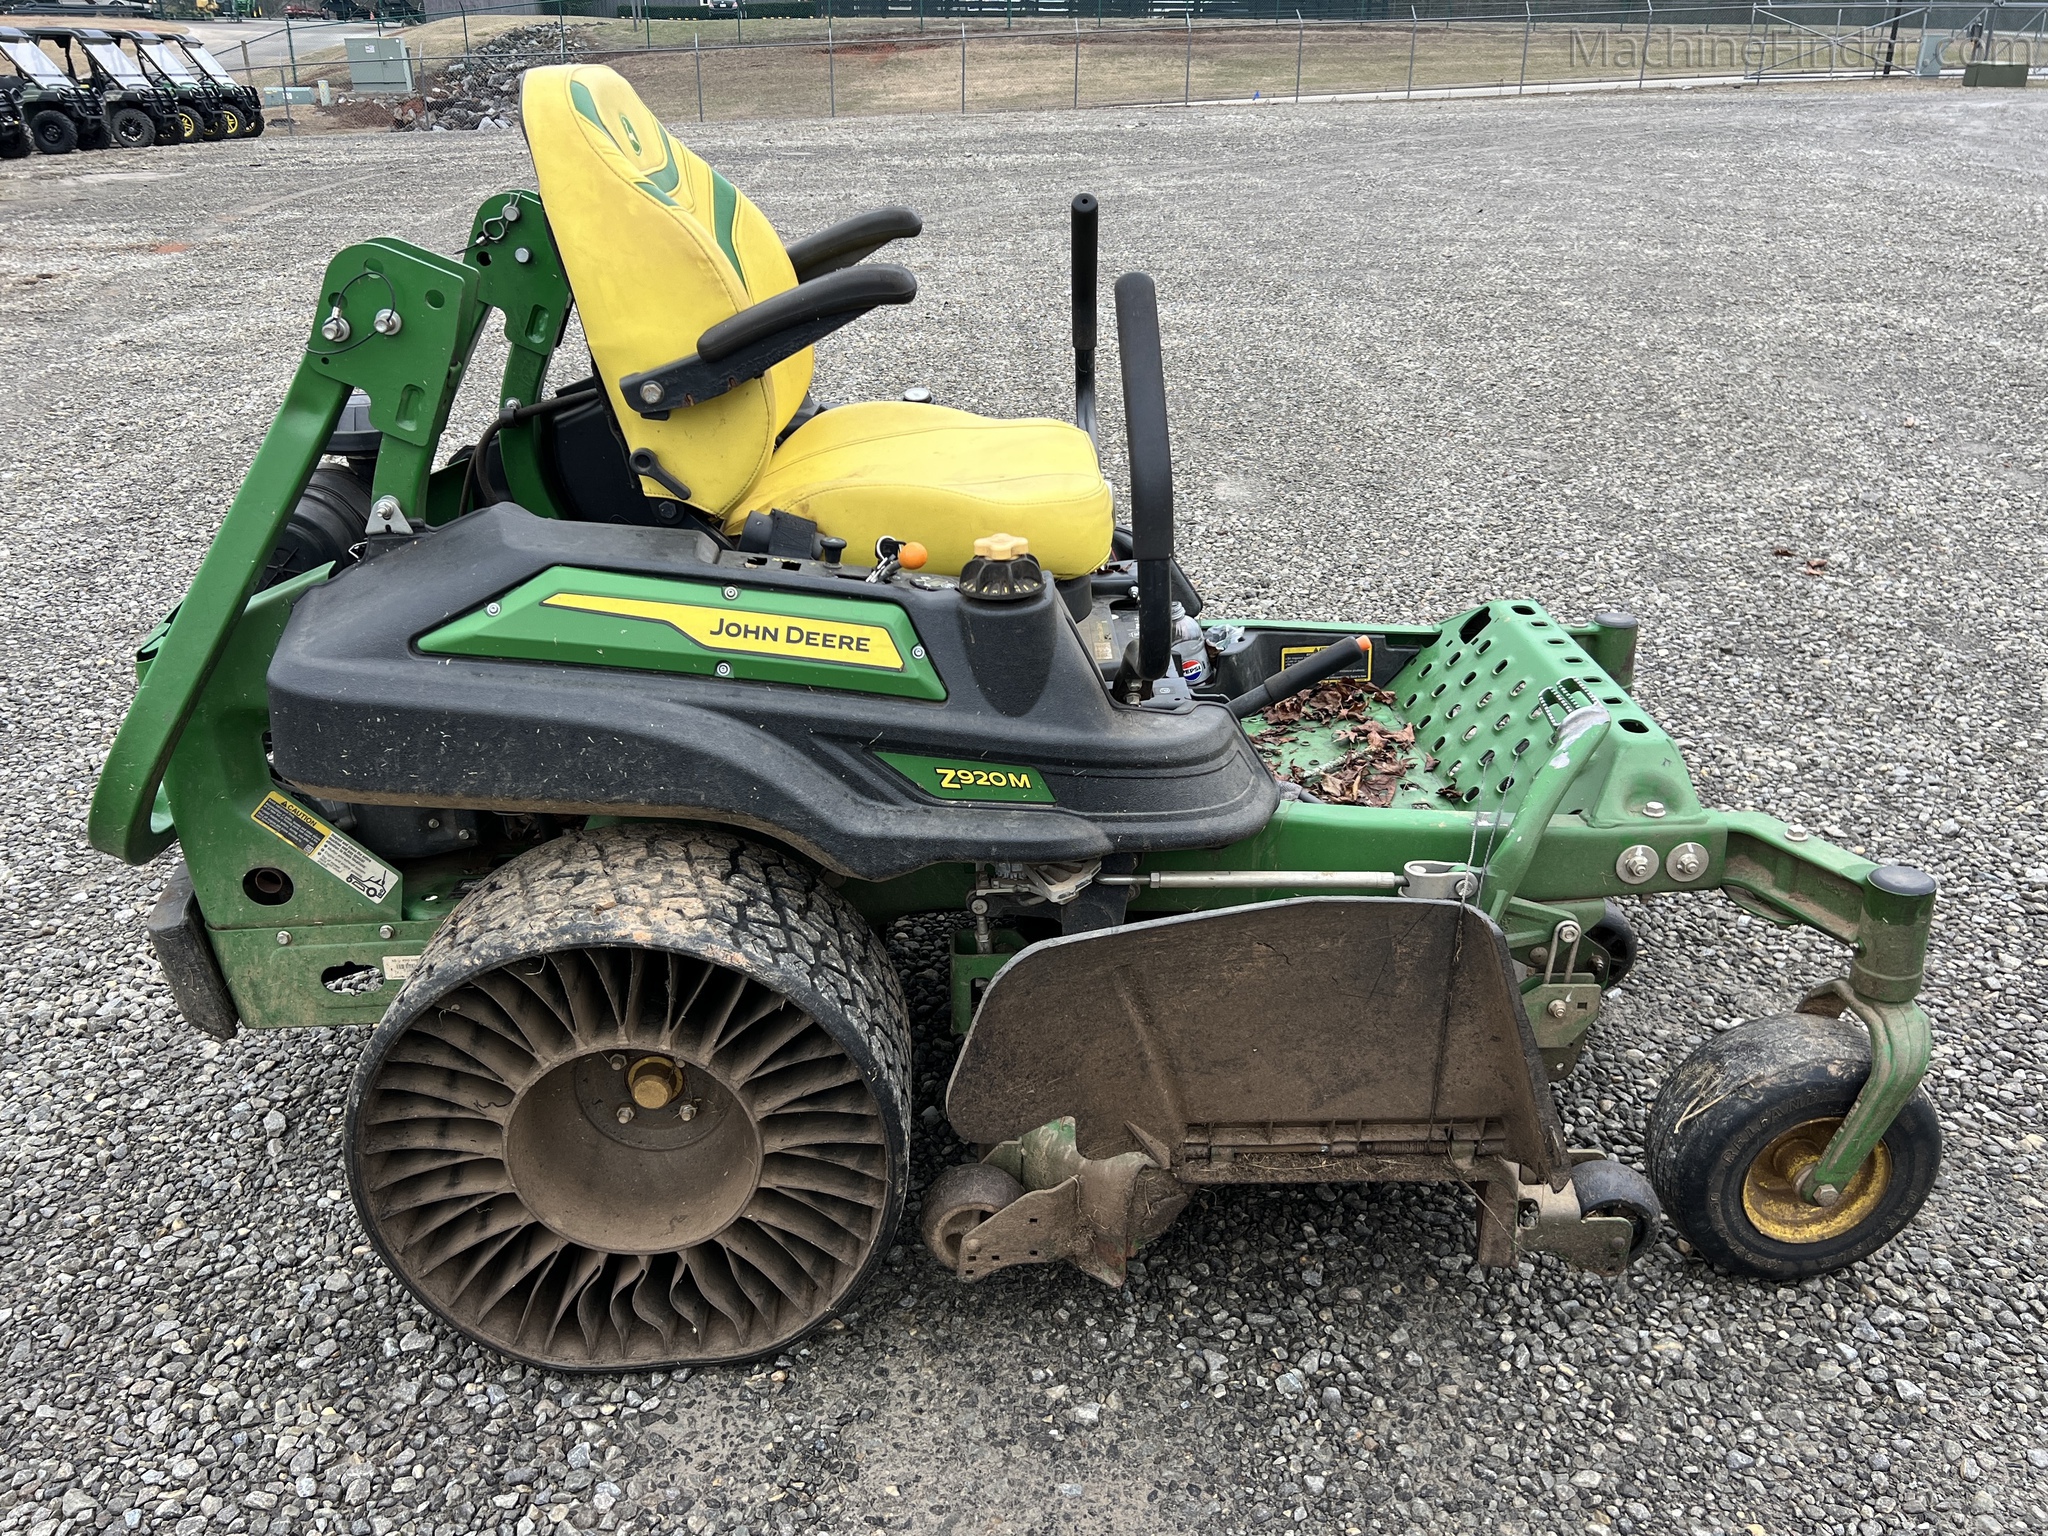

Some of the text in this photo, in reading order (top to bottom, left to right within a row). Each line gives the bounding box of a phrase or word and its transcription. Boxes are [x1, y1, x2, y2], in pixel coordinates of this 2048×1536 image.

[710, 618, 871, 652] JOHN DEERE
[935, 767, 1032, 790] Z920M
[286, 803, 317, 827] CAUTION
